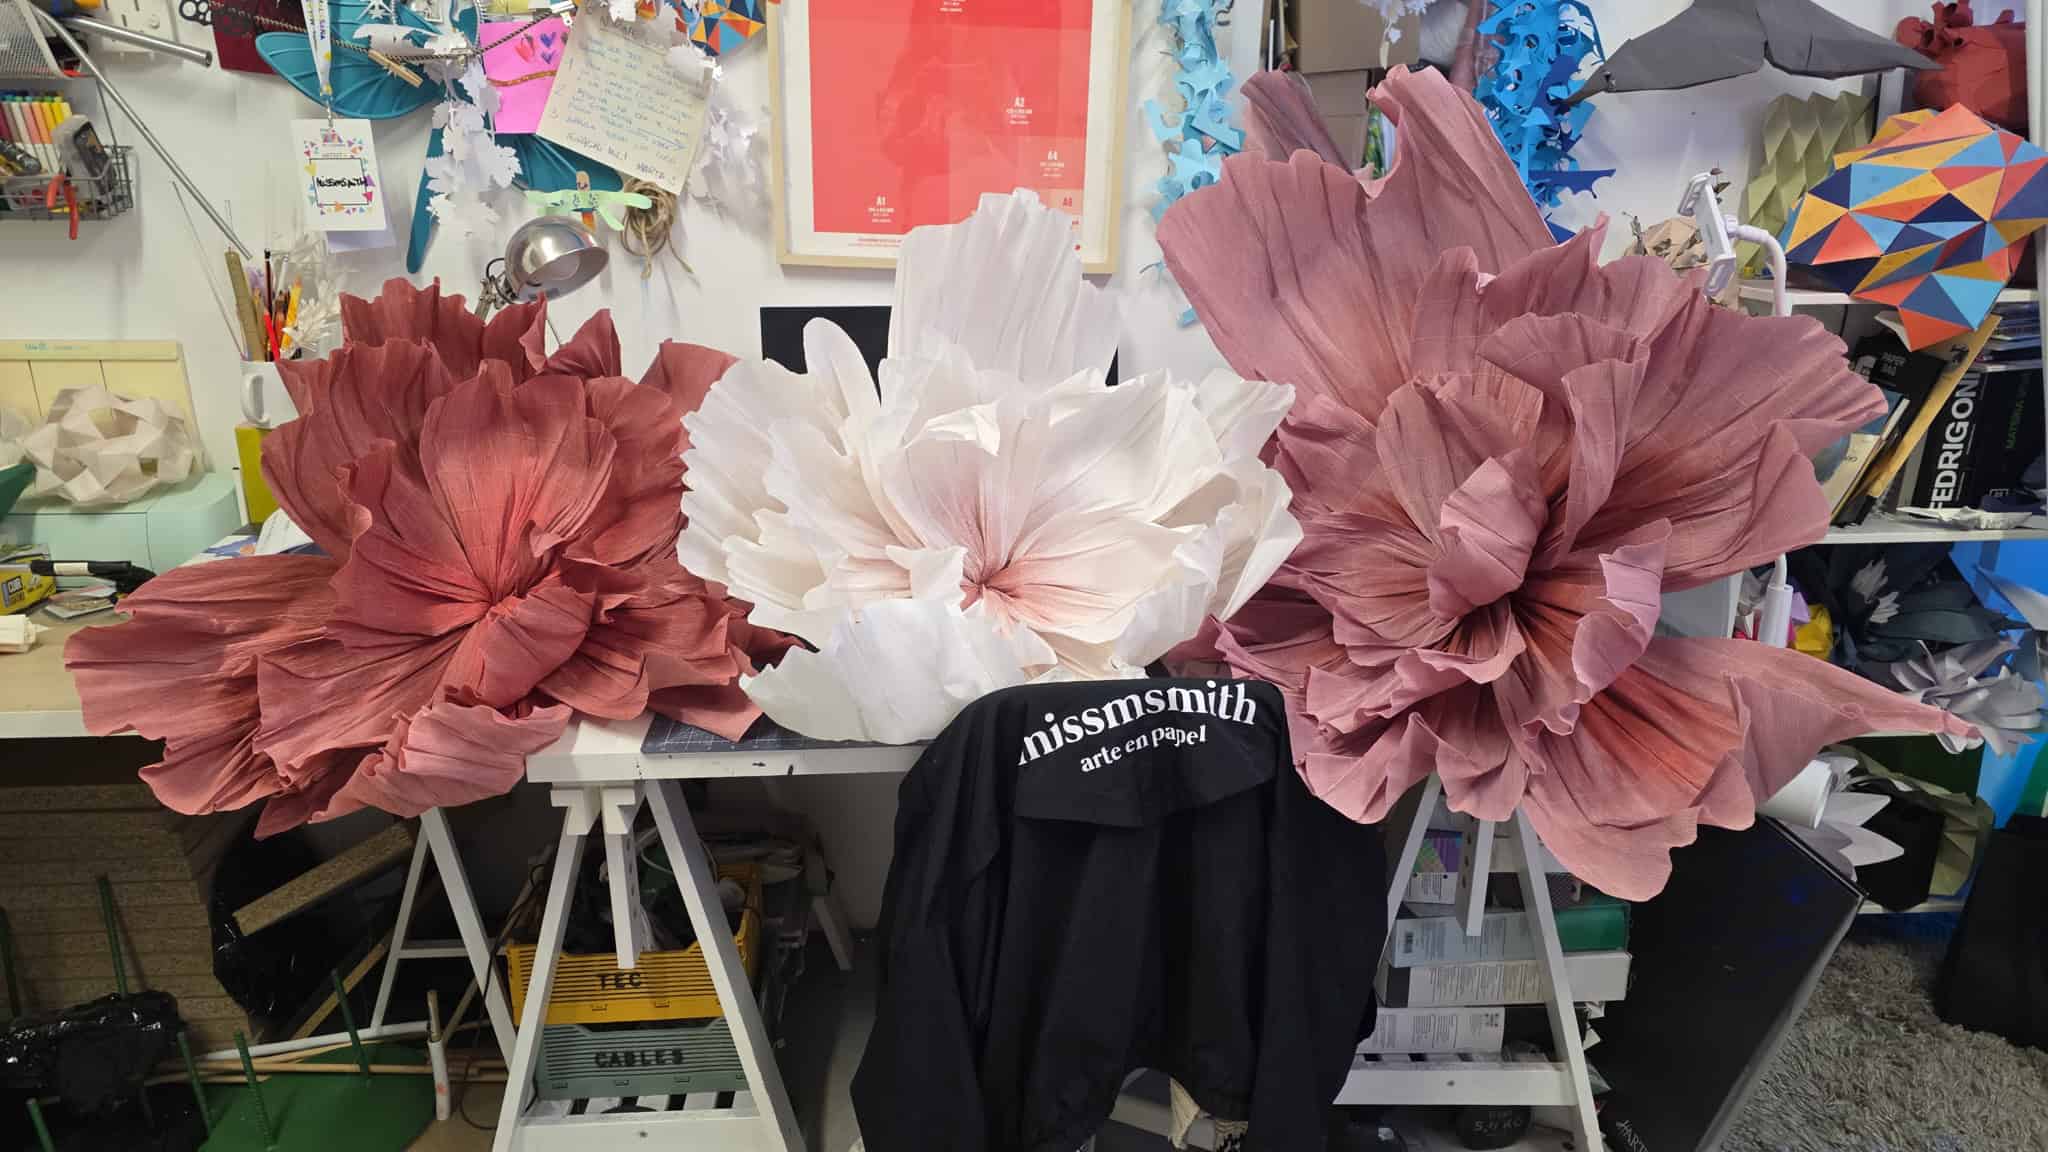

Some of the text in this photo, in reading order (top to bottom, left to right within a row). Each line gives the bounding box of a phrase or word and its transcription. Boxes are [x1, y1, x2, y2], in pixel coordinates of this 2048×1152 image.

[1014, 96, 1025, 107] A2
[1080, 724, 1207, 772] arte en papel
[597, 972, 642, 991] TEC
[595, 1048, 684, 1068] CABLES
